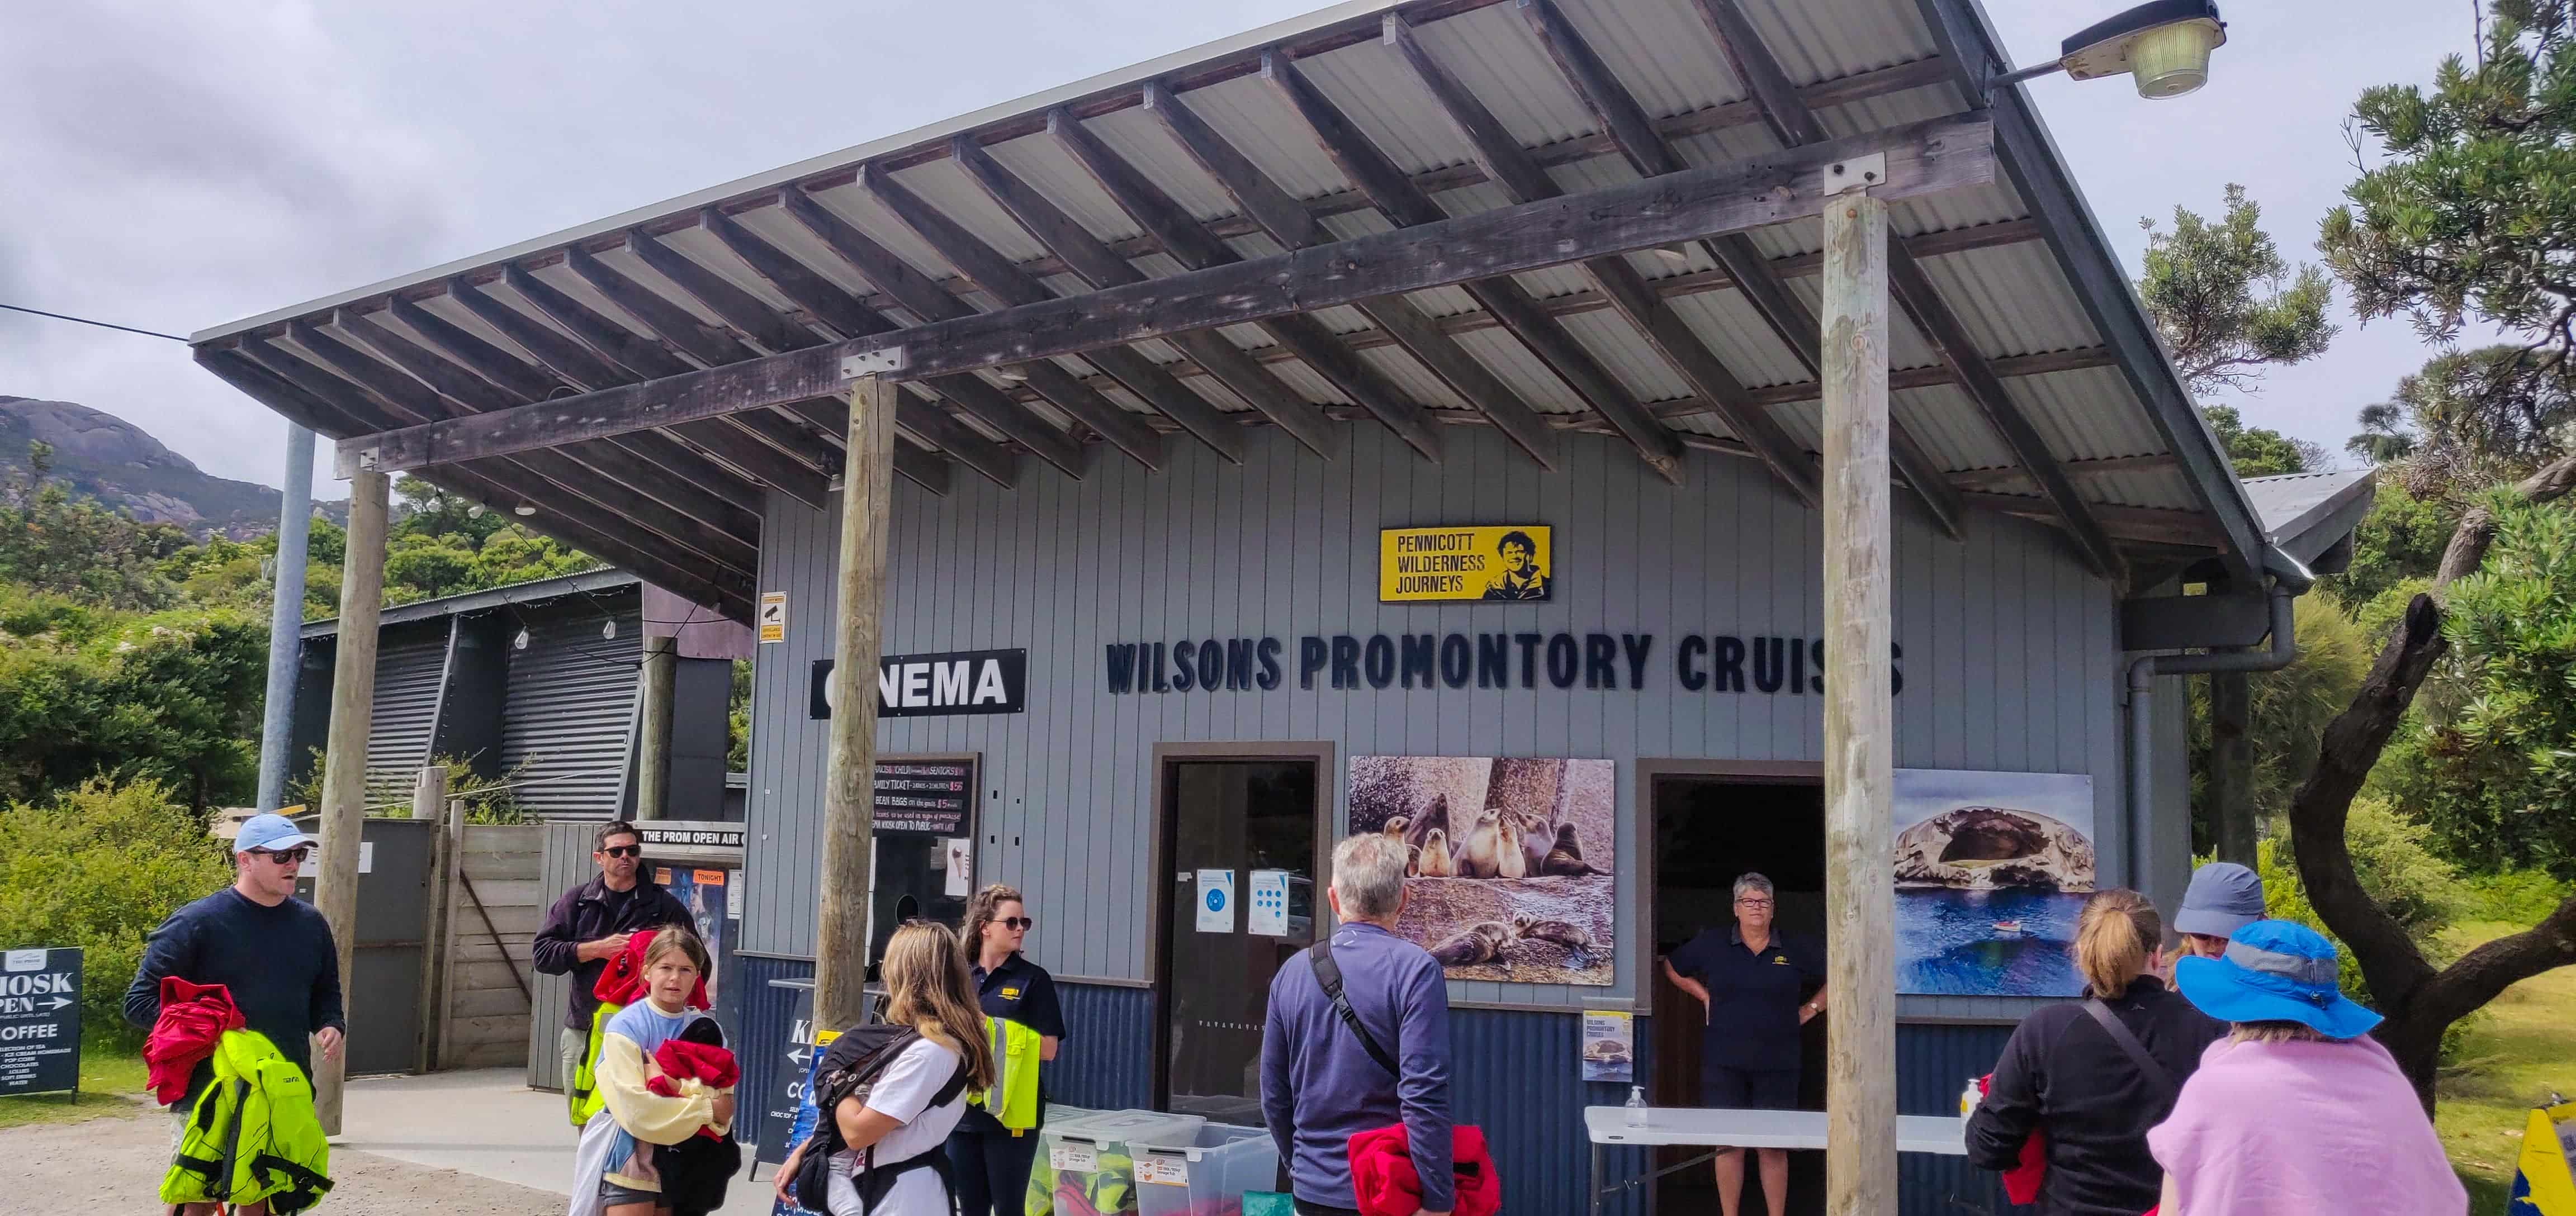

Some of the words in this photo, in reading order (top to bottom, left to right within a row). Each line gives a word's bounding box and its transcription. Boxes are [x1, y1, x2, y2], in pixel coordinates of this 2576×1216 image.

[1398, 533, 1475, 553] PENNICOTT
[1398, 554, 1485, 573] WILDERNESS
[1396, 575, 1464, 594] JOURNEYS
[1106, 637, 1281, 694] WILSONS
[1300, 634, 1653, 690] PROMONTORY
[1679, 635, 1903, 695] CRUI
[825, 659, 1007, 708] NEMA
[874, 780, 890, 789] AMILY
[890, 780, 910, 790] TICKET
[875, 796, 889, 805] BEAN
[892, 796, 907, 806] BAGS
[642, 830, 661, 842] THE
[663, 831, 690, 843] PROM
[693, 832, 719, 844] OPEN
[721, 833, 738, 844] AIR
[698, 873, 722, 882] TONIGHT
[0, 973, 74, 996] IOSK
[0, 1024, 58, 1041] OFFEE
